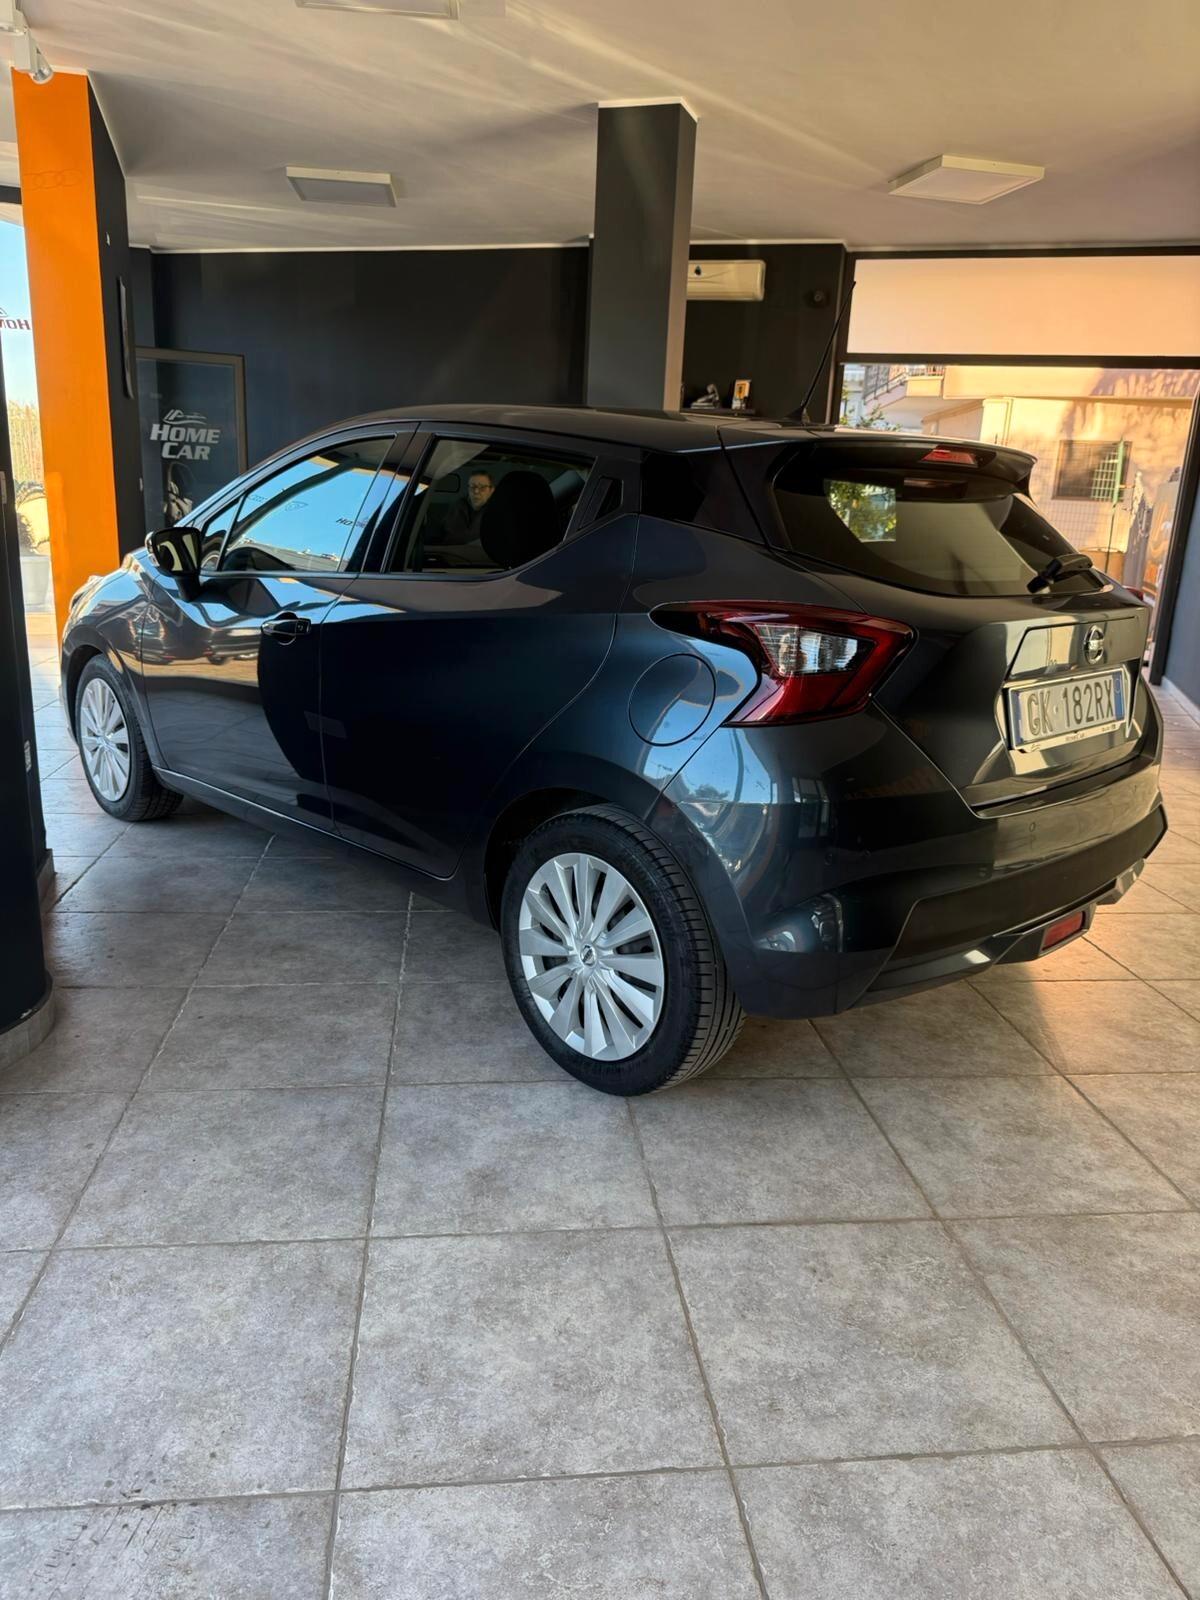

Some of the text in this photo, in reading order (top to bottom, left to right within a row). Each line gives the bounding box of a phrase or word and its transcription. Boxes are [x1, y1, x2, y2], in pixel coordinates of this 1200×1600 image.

[150, 423, 220, 443] HOME
[162, 442, 210, 460] CAR
[1027, 679, 1115, 736] GK 182RX
